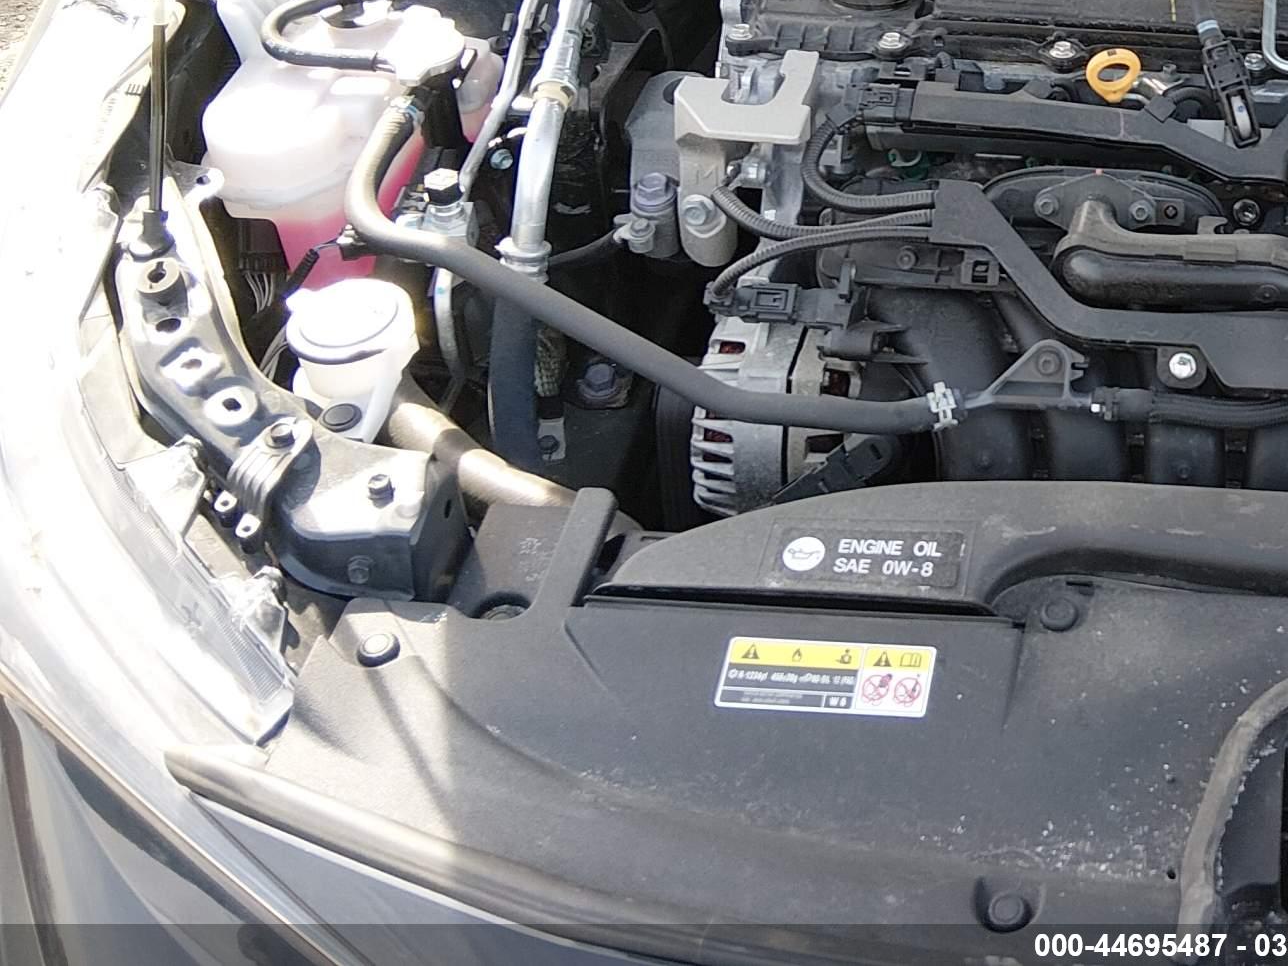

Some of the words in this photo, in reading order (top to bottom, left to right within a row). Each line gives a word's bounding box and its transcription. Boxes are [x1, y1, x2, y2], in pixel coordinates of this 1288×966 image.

[837, 538, 904, 556] ENGINE
[913, 540, 943, 558] OIL
[833, 557, 871, 574] SAE
[882, 560, 934, 577] 0W-8
